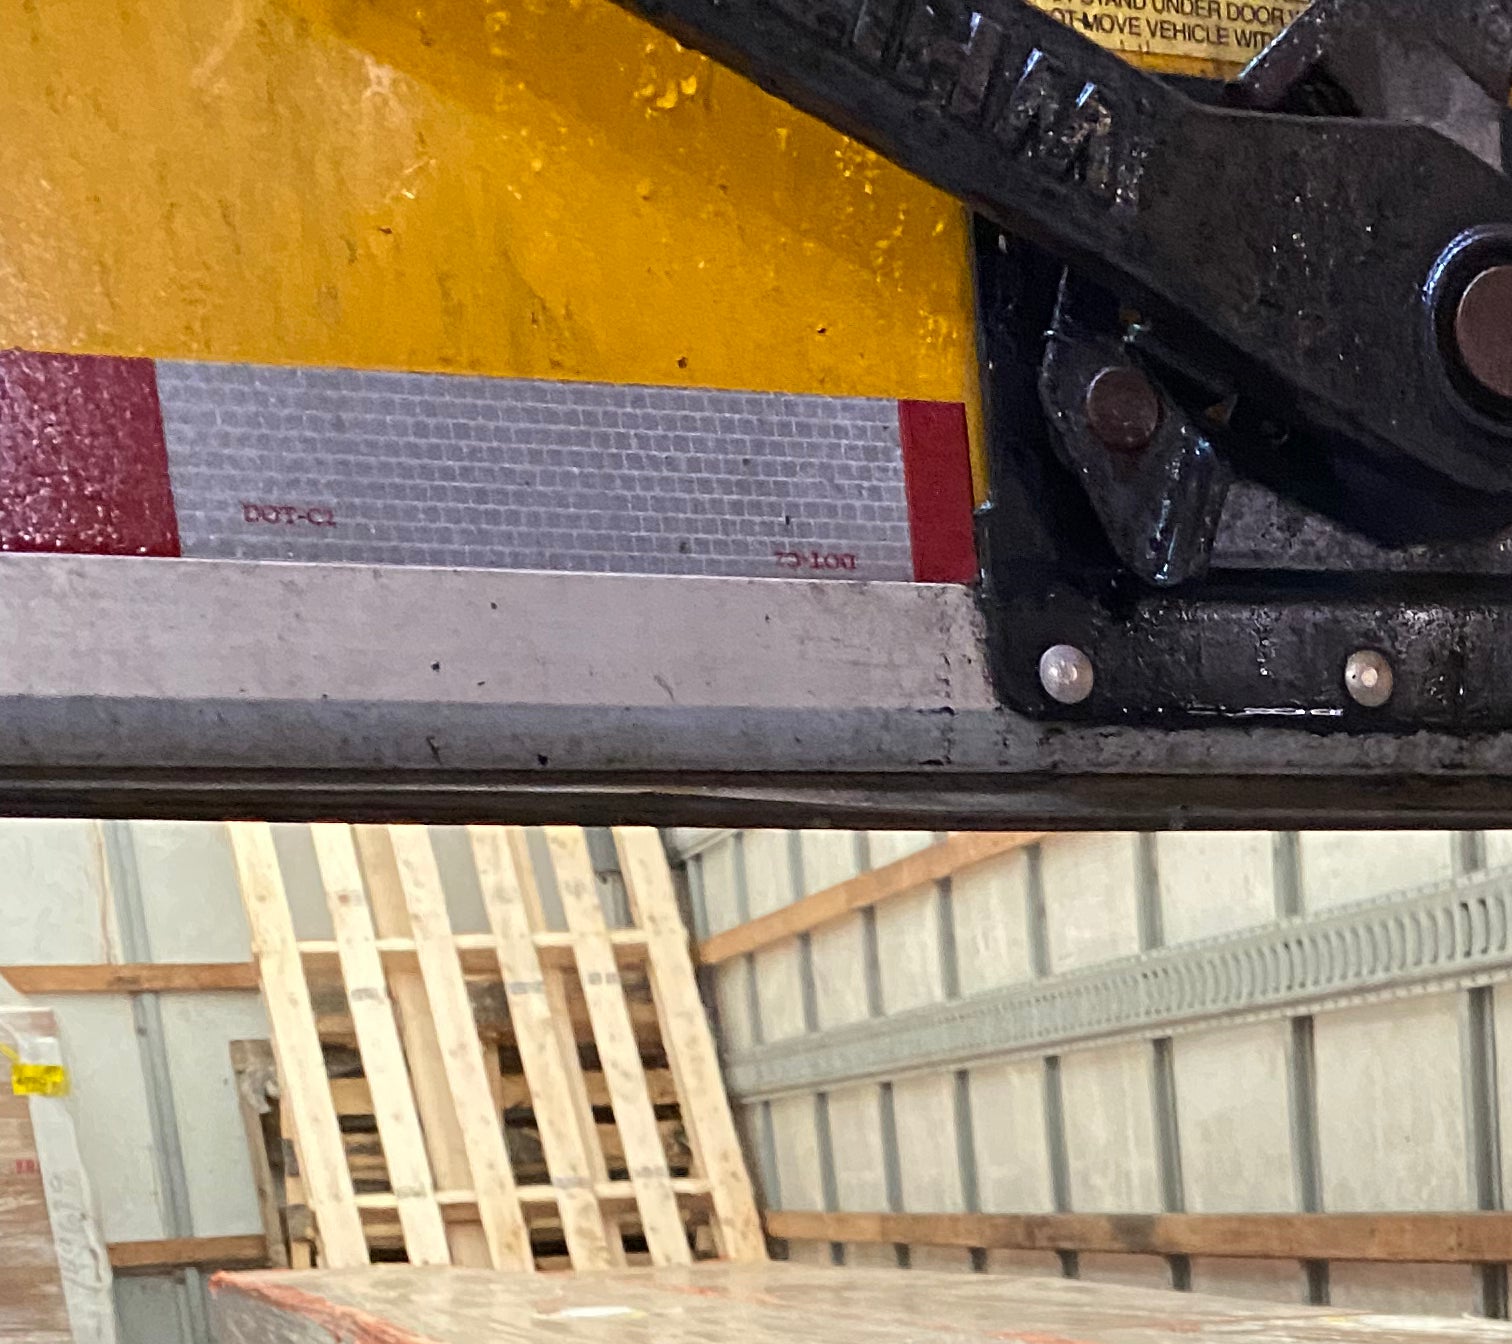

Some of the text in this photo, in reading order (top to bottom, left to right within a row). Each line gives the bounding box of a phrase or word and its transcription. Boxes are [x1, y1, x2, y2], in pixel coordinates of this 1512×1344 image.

[1052, 8, 1076, 29] OT
[1082, 11, 1141, 37] MOVE
[1146, 18, 1229, 46] VEHICLE
[1227, 1, 1284, 26] DOOR
